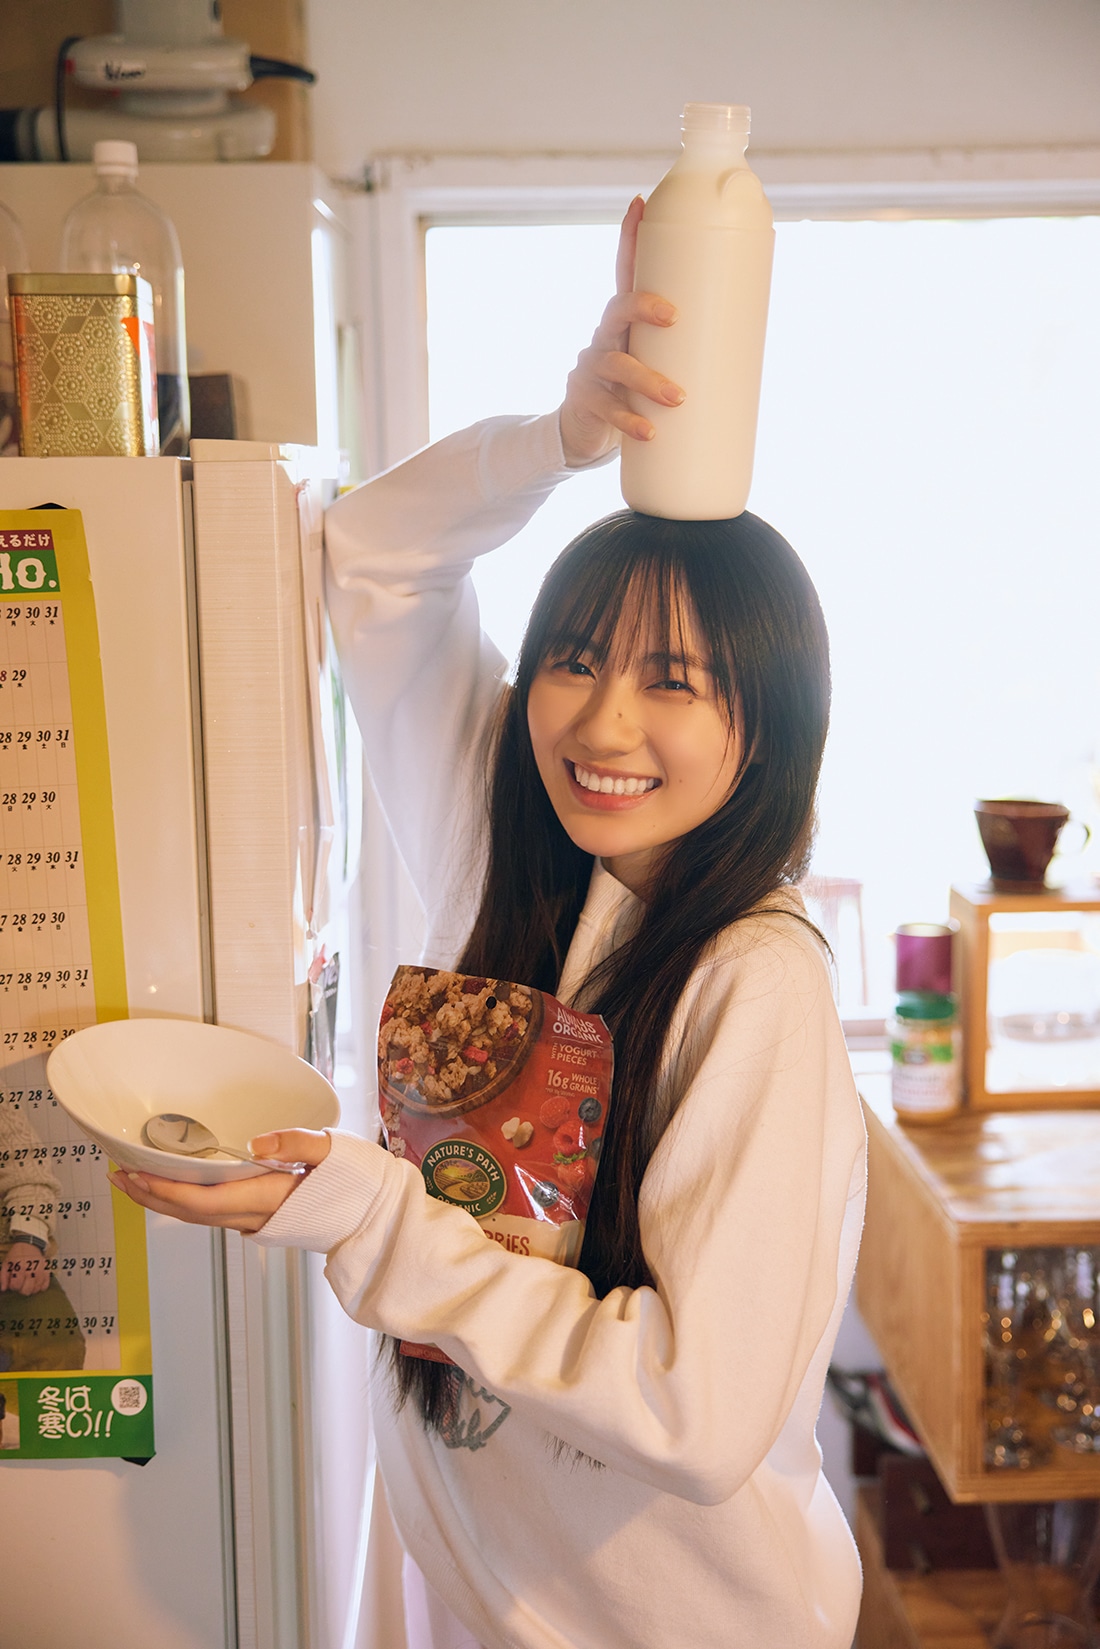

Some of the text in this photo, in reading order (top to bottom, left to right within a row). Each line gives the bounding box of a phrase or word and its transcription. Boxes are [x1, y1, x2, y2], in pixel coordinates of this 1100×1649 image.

[6, 606, 59, 619] 29 30 31
[12, 669, 27, 681] 29
[17, 731, 32, 743] 29
[36, 730, 51, 742] 30
[55, 729, 70, 741] 31
[2, 791, 56, 805] 28 29 30
[7, 851, 79, 865] 28 29 30 31
[12, 914, 27, 926] 28
[31, 912, 46, 925] 29
[50, 911, 66, 924] 30
[0, 969, 89, 985] 27 28 29 30 31
[557, 1007, 597, 1034] ALWAYS
[3, 1032, 18, 1044] 27
[23, 1031, 38, 1043] 28
[42, 1030, 57, 1042] 29
[552, 1021, 604, 1044] ORGANIC
[558, 1044, 597, 1058] YOGURT
[556, 1052, 588, 1066] PIECES
[547, 1069, 570, 1090] 16g
[571, 1073, 597, 1086] WHOLE
[9, 1091, 24, 1103] 27
[28, 1089, 43, 1101] 28
[47, 1089, 55, 1100] 2
[14, 1149, 29, 1160] 27
[33, 1147, 48, 1159] 28
[52, 1146, 67, 1158] 29
[71, 1145, 86, 1157] 30
[427, 1144, 500, 1182] NATURE'S PATH
[2, 1201, 91, 1217] 26 27 28 29 30
[7, 1257, 113, 1273] 26 27 28 29 30 31
[10, 1319, 25, 1331] 26
[29, 1318, 43, 1330] 27
[47, 1318, 61, 1330] 28
[65, 1317, 79, 1329] 29
[83, 1316, 98, 1328] 30
[102, 1316, 116, 1328] 31
[37, 1385, 93, 1413] 冬は
[37, 1410, 115, 1439] 寒い!!
